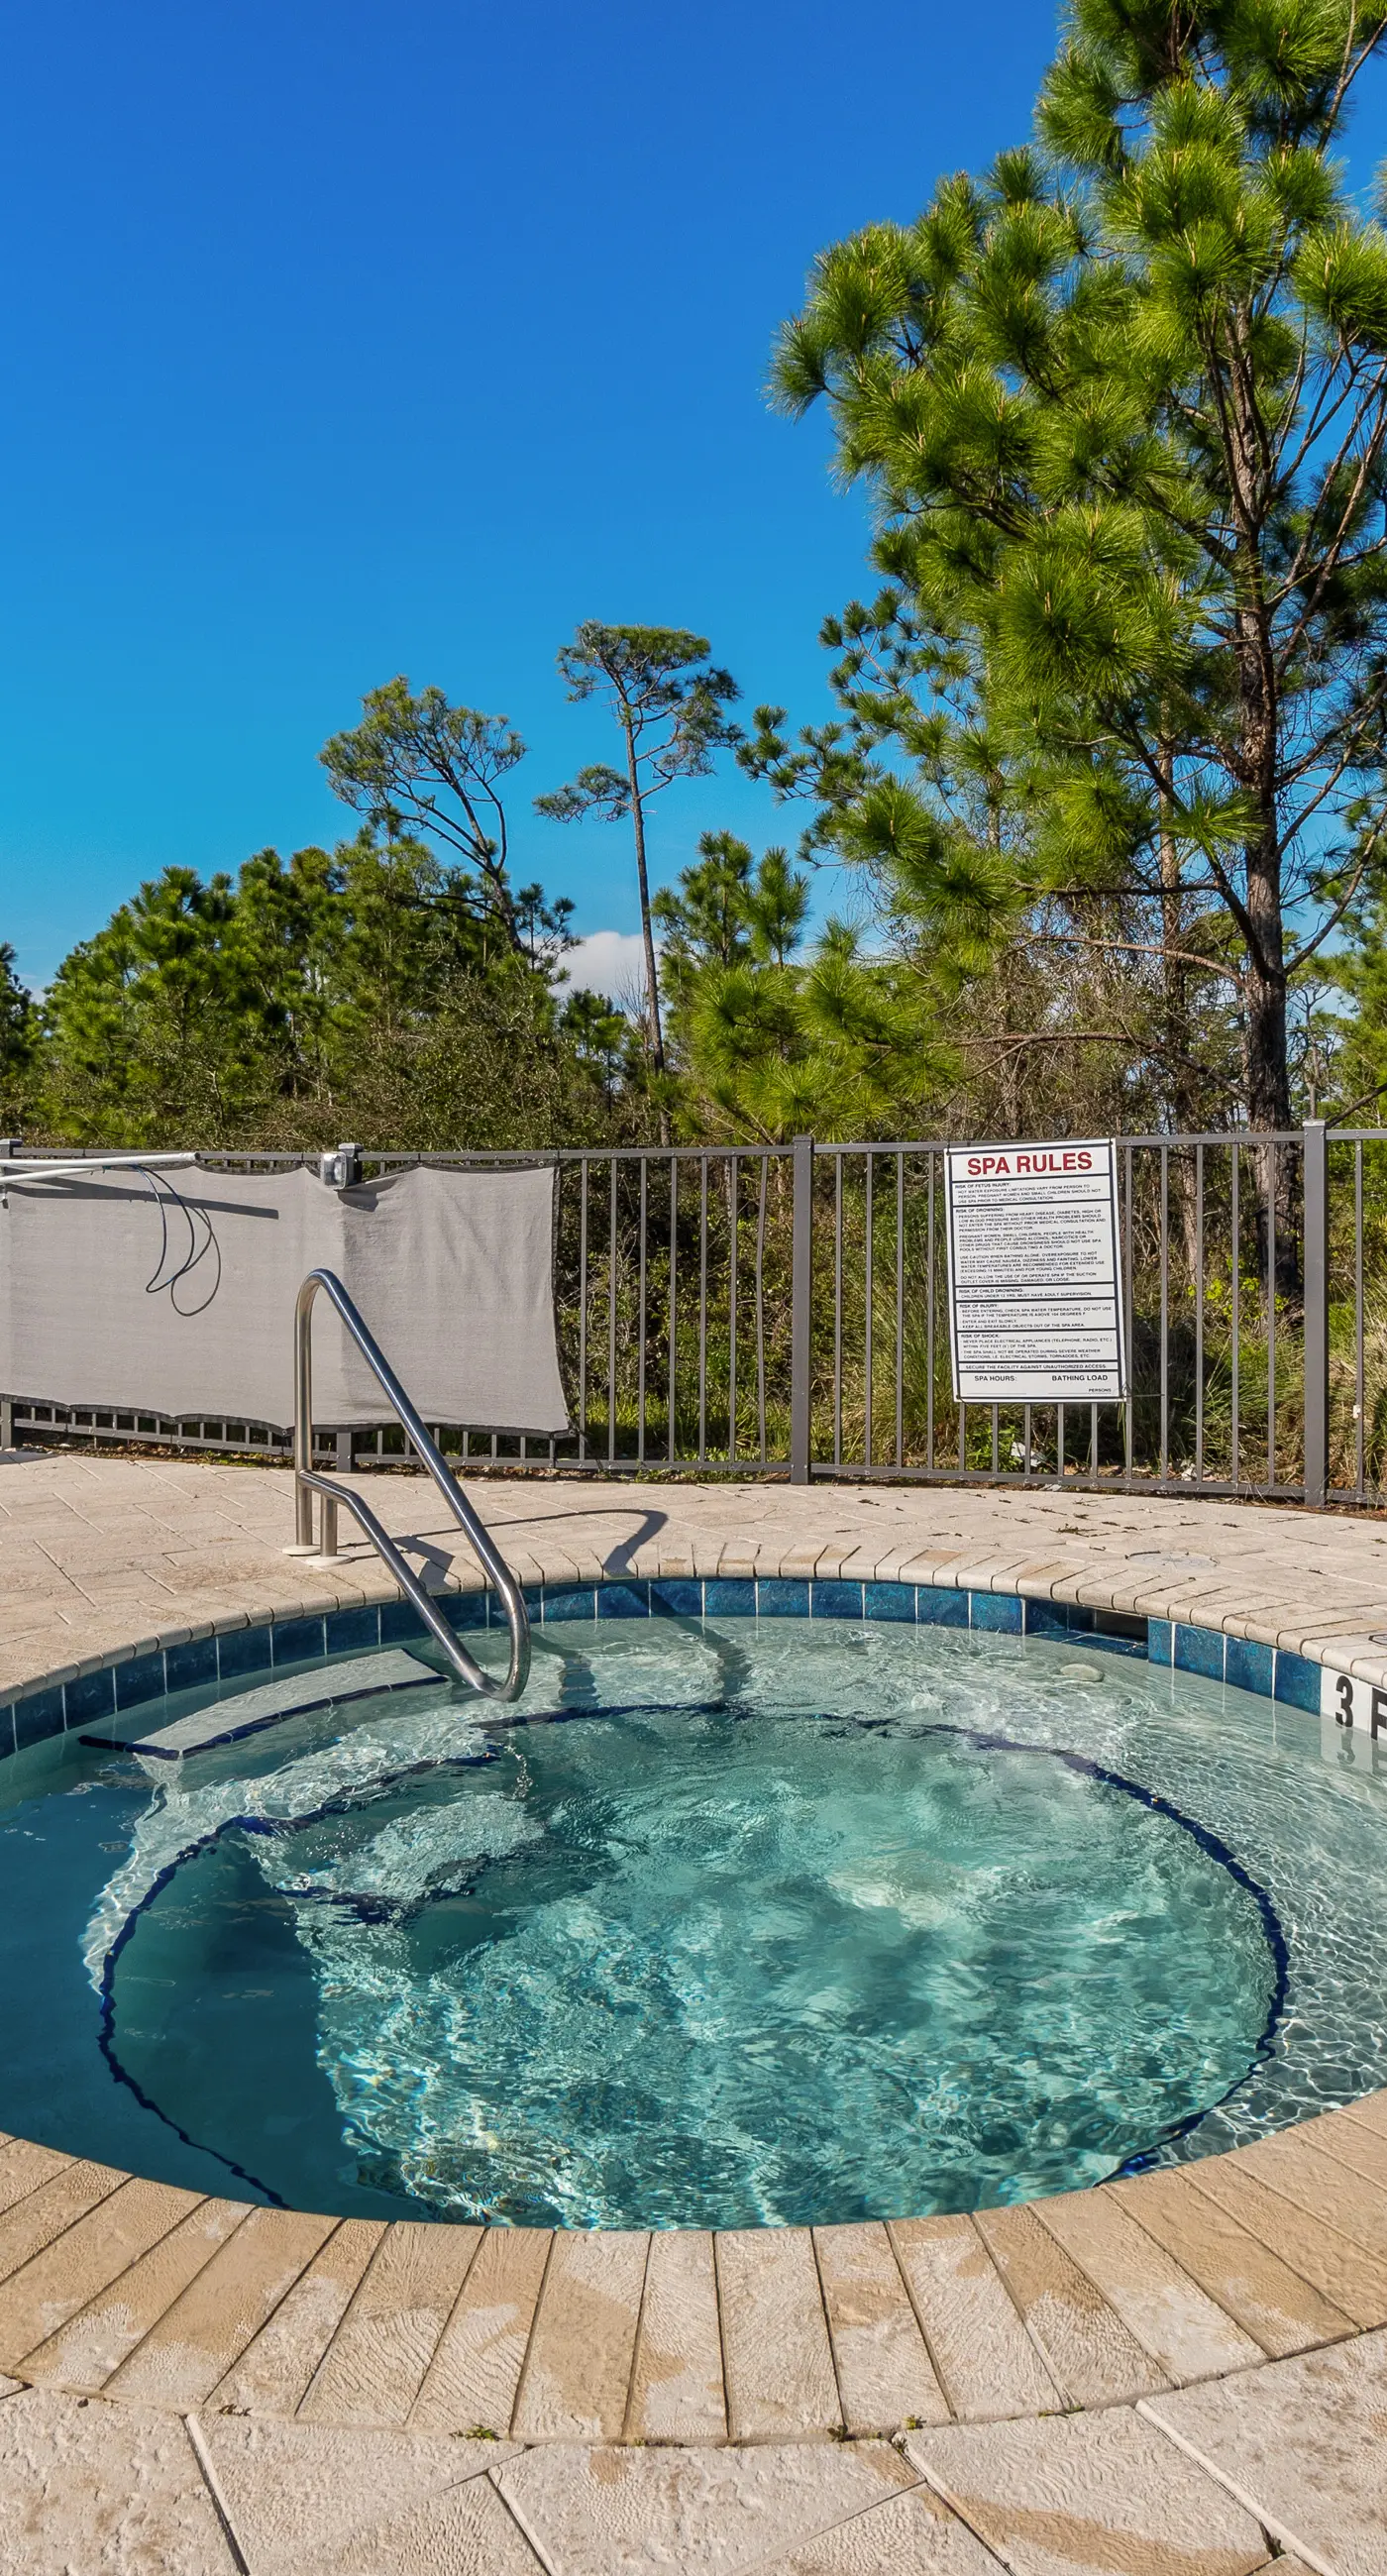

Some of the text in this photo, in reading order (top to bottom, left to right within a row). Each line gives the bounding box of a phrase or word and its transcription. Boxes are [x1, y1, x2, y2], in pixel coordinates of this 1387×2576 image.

[967, 1151, 1093, 1176] SPA RULES
[1335, 1675, 1353, 1728] 3
